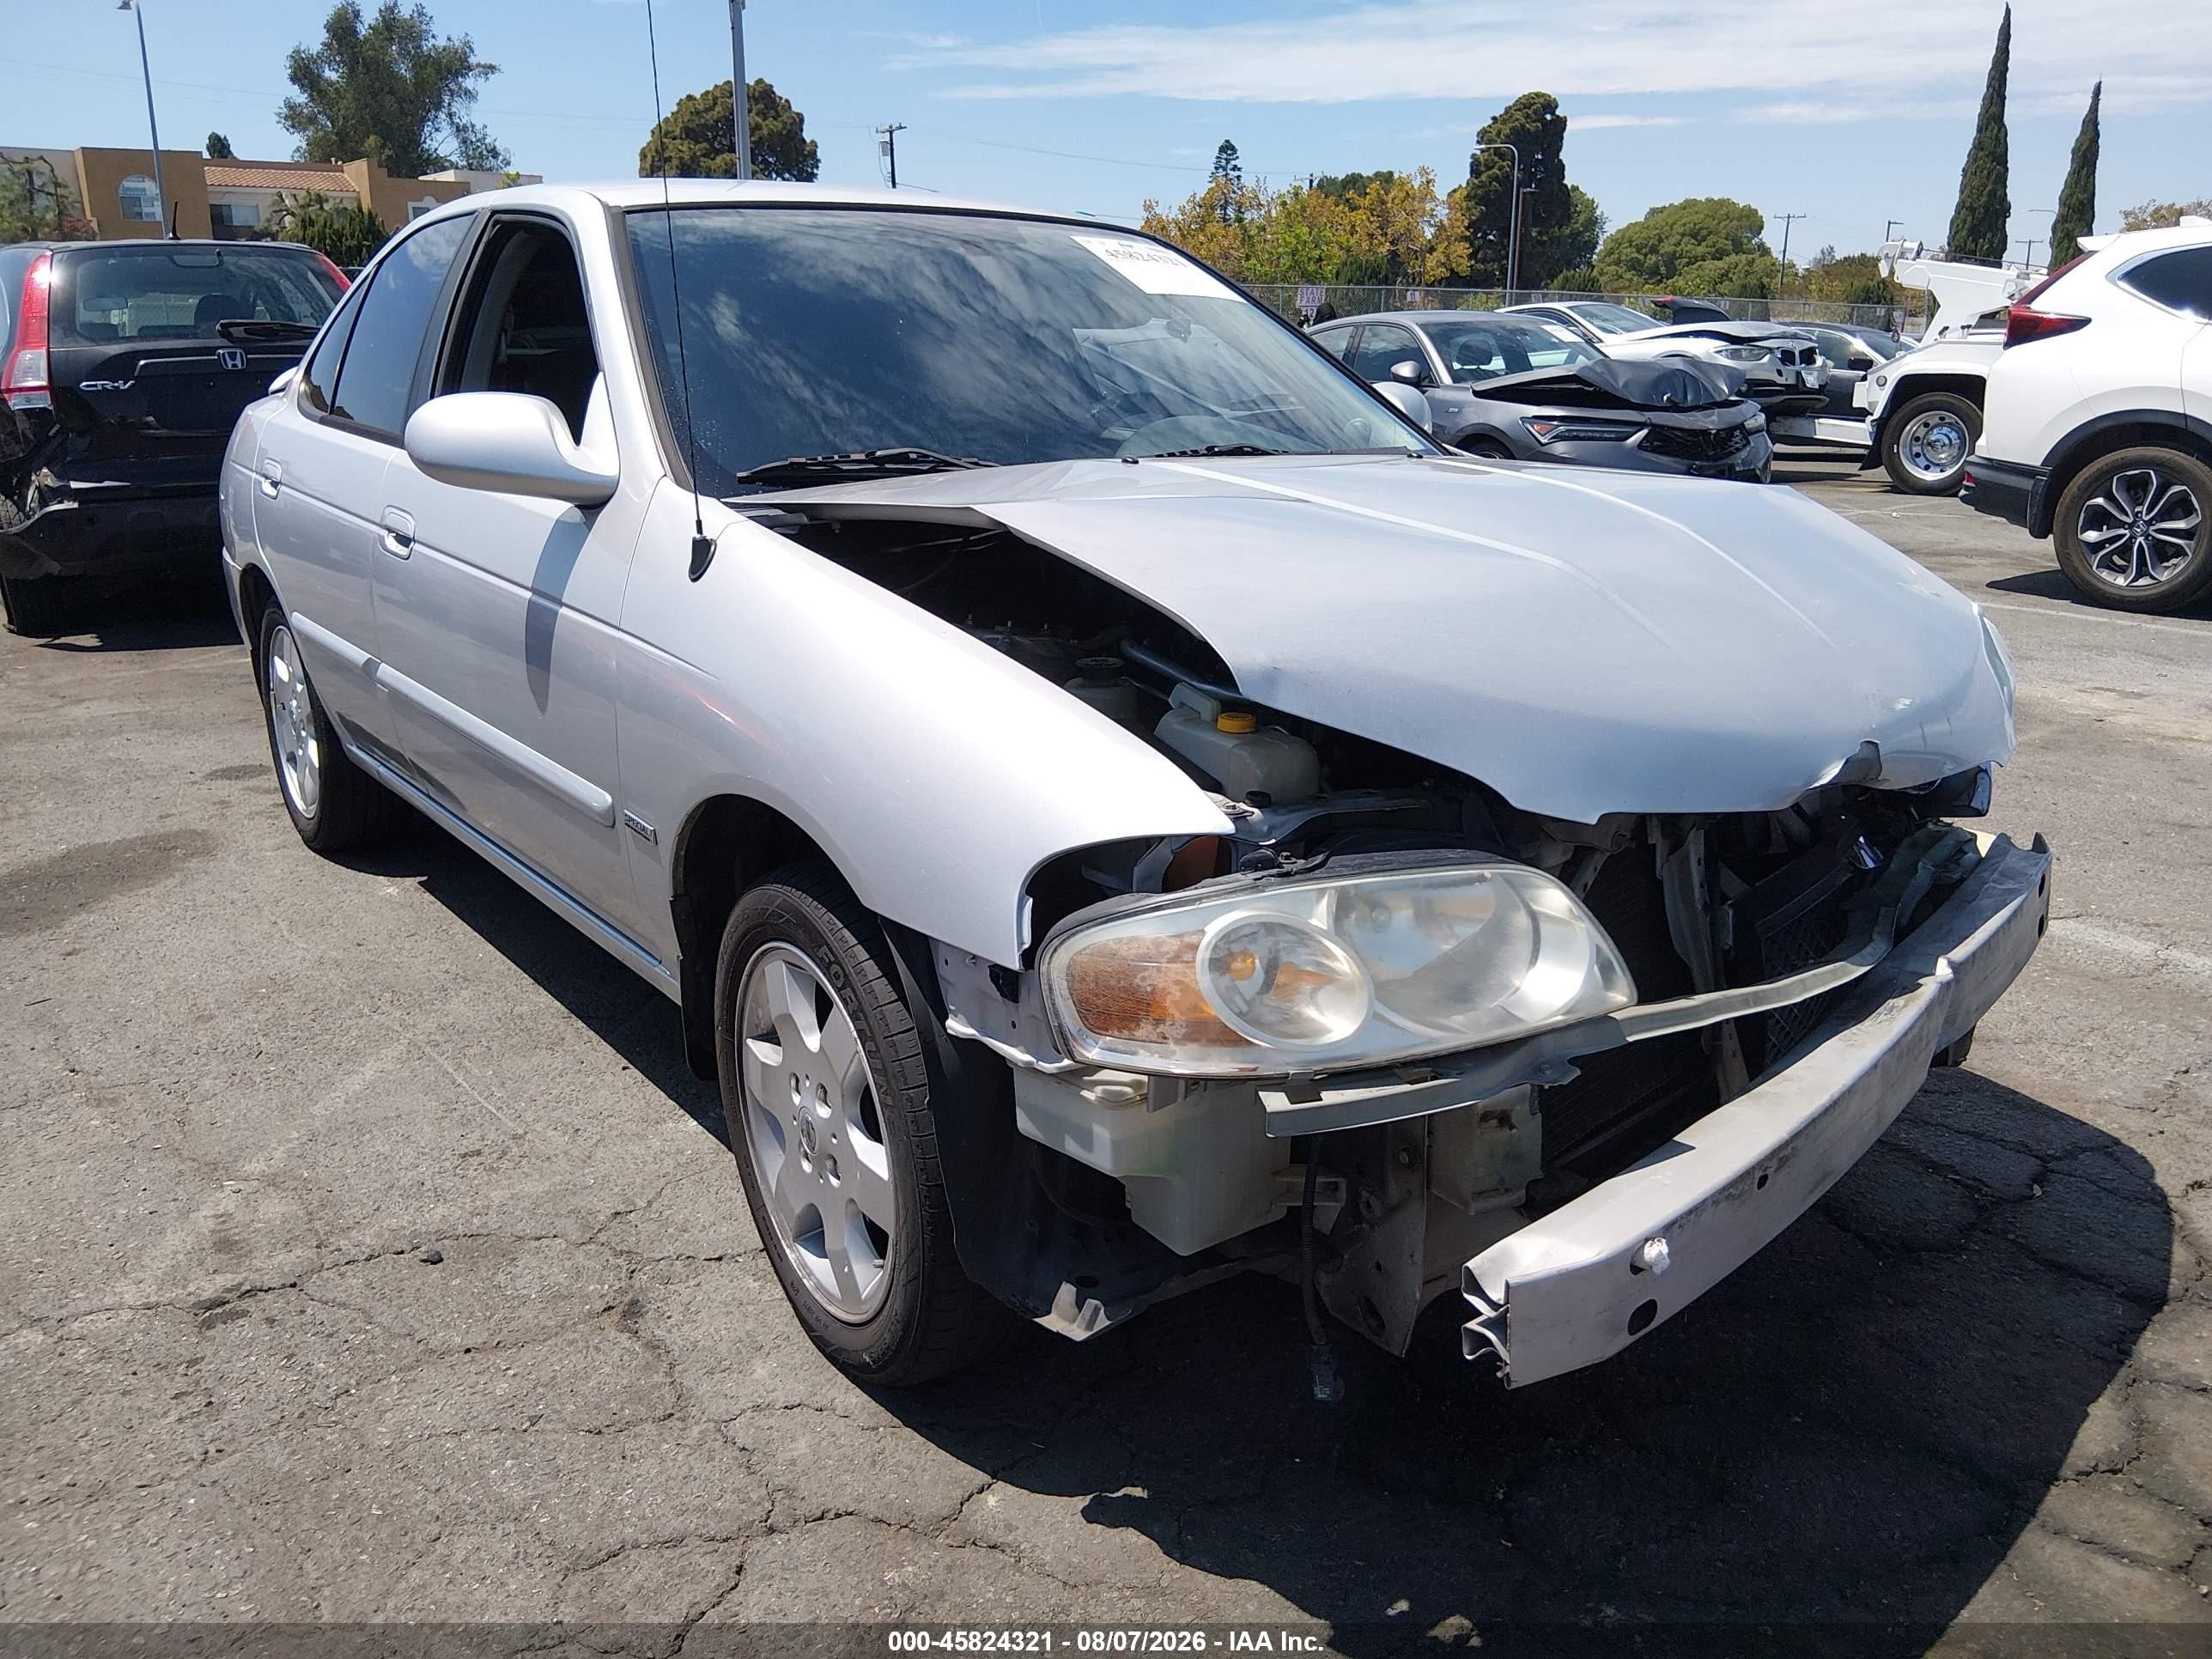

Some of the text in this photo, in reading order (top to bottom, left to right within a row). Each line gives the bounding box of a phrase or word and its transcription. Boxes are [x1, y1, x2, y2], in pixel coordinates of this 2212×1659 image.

[1299, 288, 1325, 296] STATE
[1299, 296, 1323, 305] FARM
[79, 380, 136, 391] CR-V
